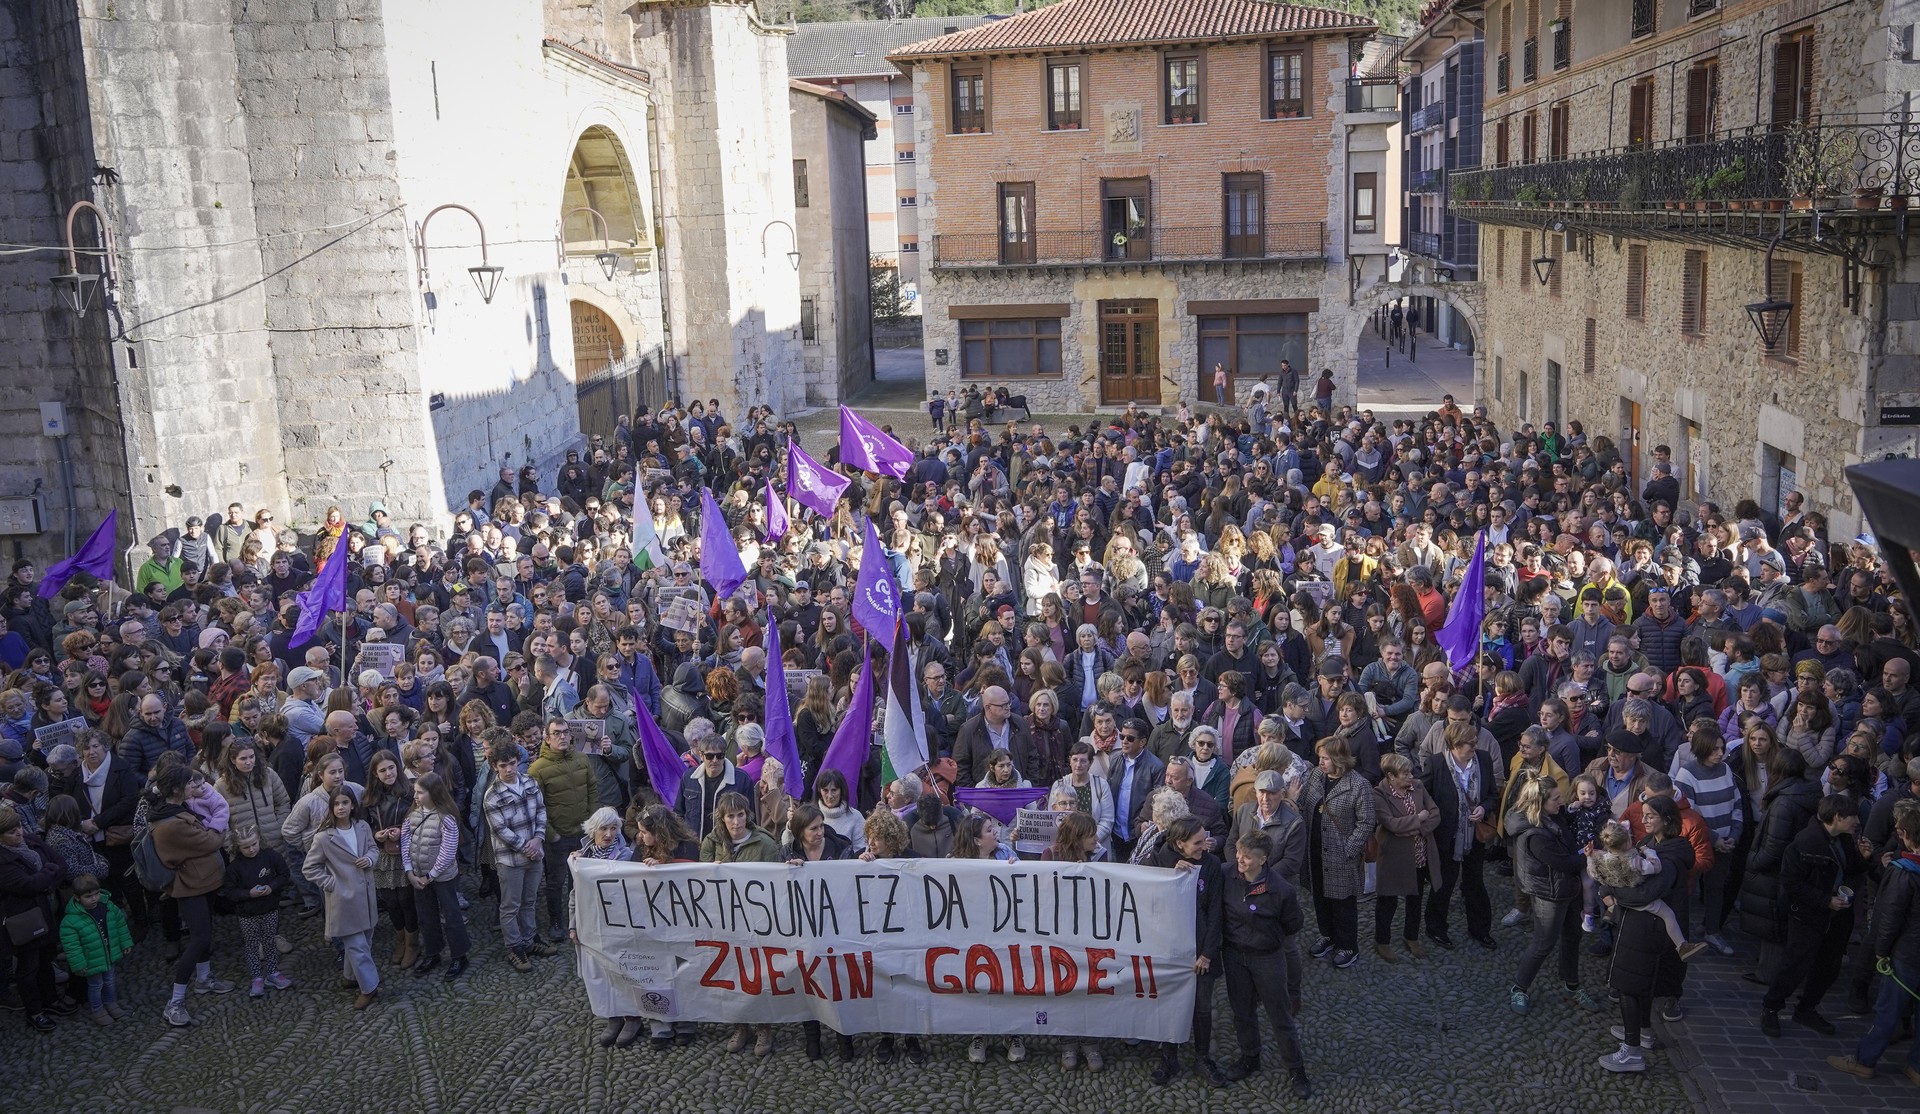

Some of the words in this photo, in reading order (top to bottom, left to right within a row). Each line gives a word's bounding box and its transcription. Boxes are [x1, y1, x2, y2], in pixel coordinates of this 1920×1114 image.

[574, 314, 600, 324] CIMUS
[575, 325, 607, 334] RISTUM
[575, 335, 613, 344] REXISSE
[1019, 811, 1054, 820] ELKARTASUNA
[1033, 820, 1054, 828] DELITUA
[596, 877, 840, 938] ELKARTASUNA
[855, 874, 905, 935] EZ
[923, 873, 969, 931] DA
